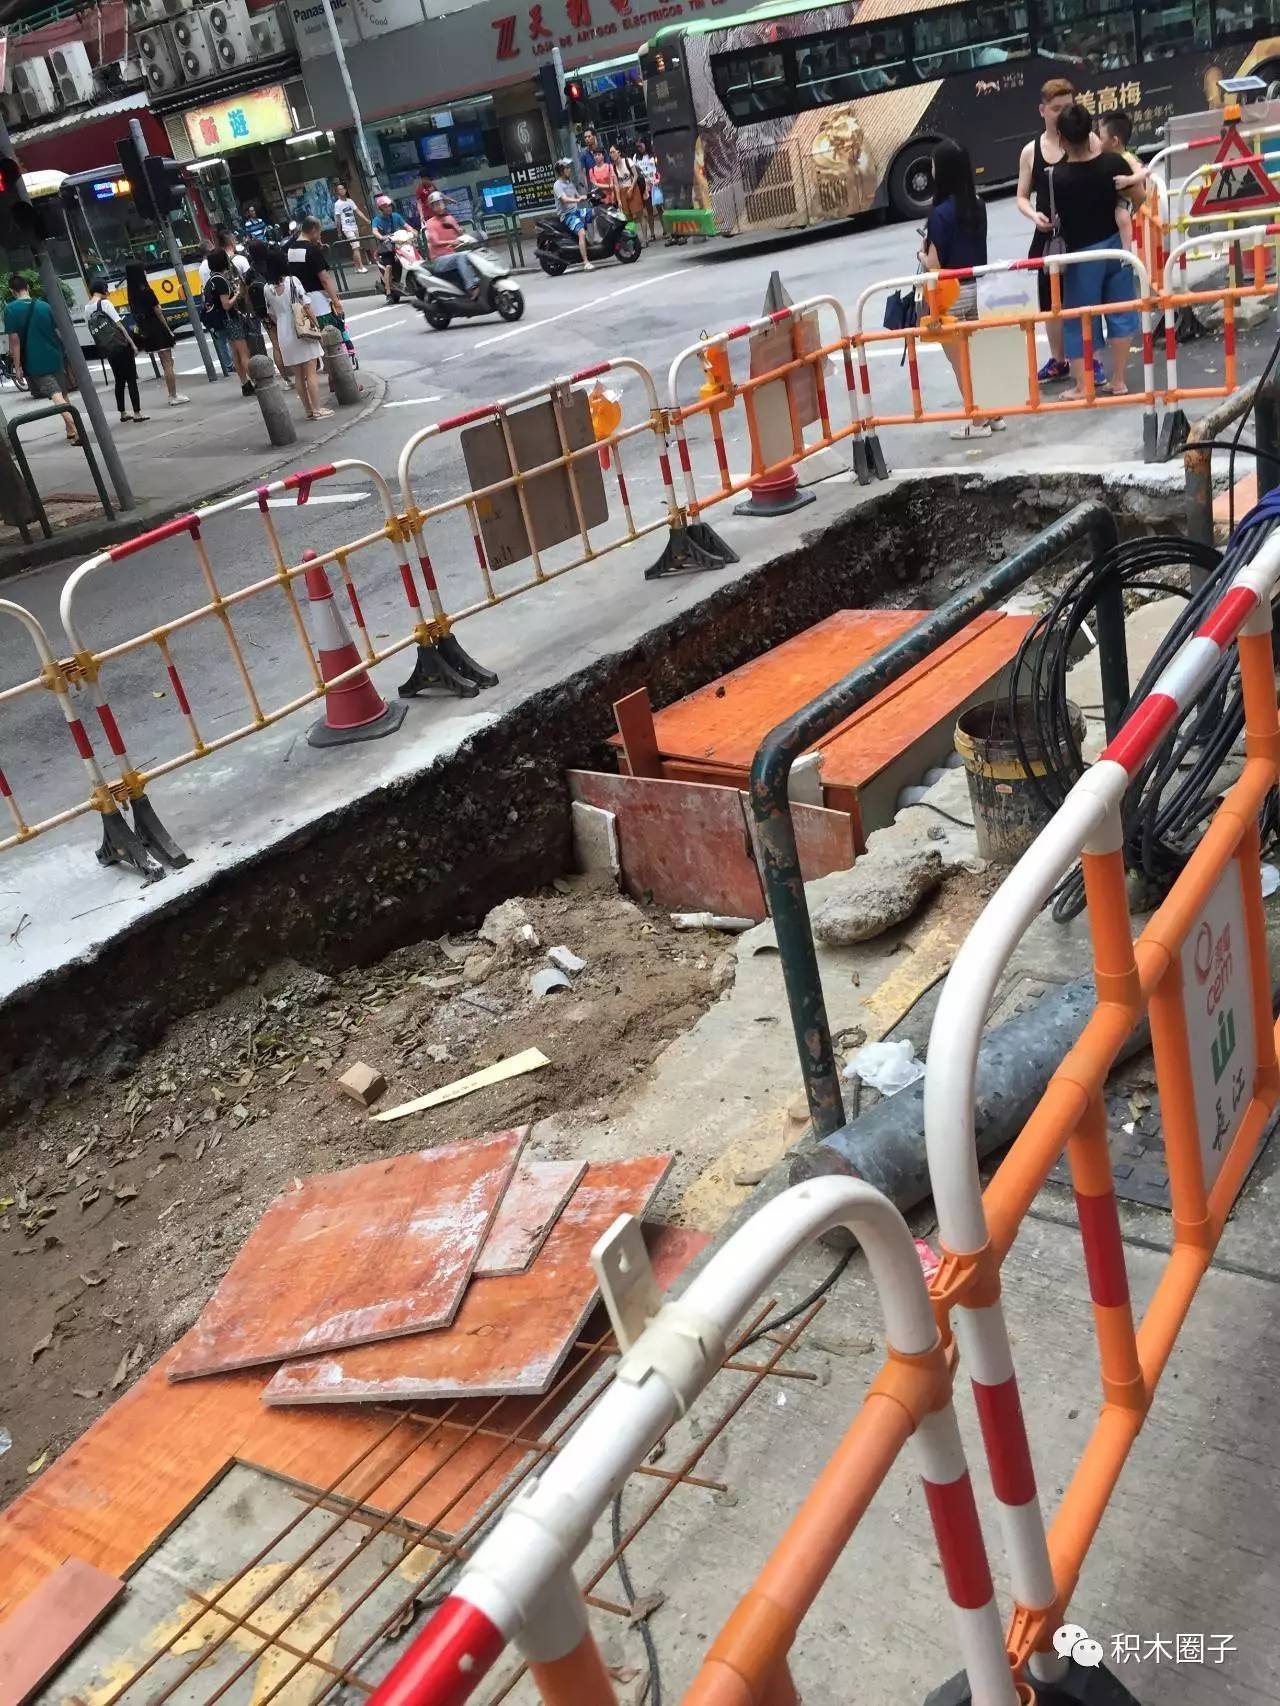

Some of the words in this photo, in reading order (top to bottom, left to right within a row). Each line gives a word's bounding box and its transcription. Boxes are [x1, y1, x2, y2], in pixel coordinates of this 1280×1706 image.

[293, 0, 347, 23] Panasnic
[577, 22, 618, 42] ARTIGOS
[622, 4, 683, 30] ELECTRICOS
[1074, 81, 1141, 115] 美高梅
[511, 167, 537, 184] IHE
[536, 163, 553, 174] 2017
